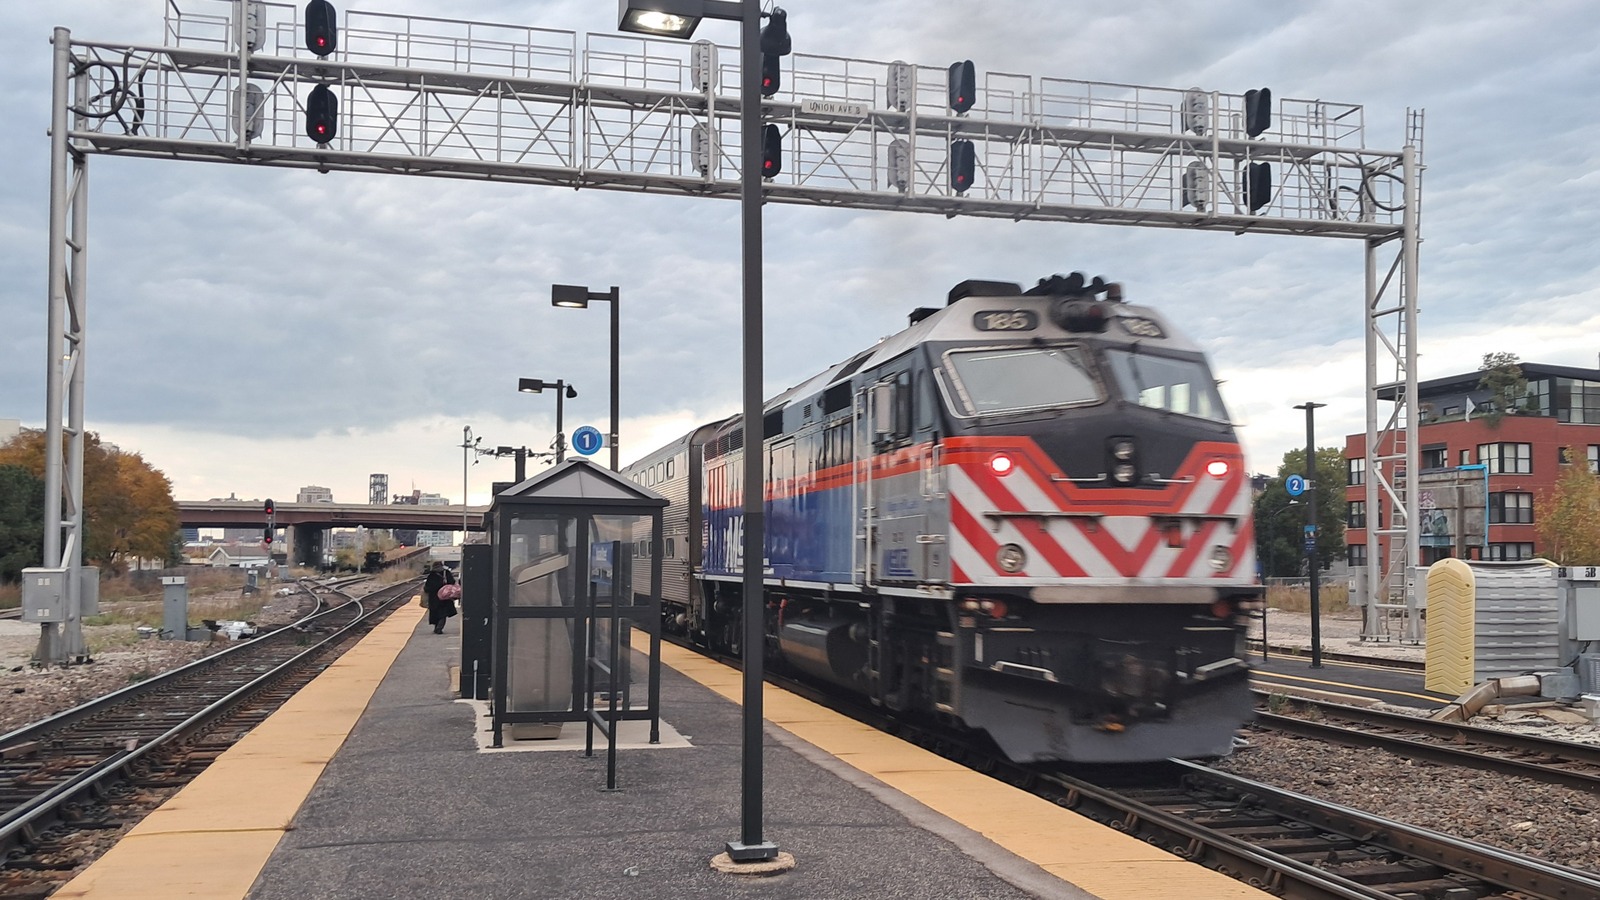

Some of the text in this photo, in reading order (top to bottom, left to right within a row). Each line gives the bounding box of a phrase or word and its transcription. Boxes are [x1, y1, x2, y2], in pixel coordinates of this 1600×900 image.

[809, 102, 835, 113] UNION
[838, 105, 852, 114] AVE
[982, 312, 1029, 329] 185
[582, 433, 590, 448] 1
[1292, 480, 1299, 490] 2
[1585, 567, 1596, 578] 5B
